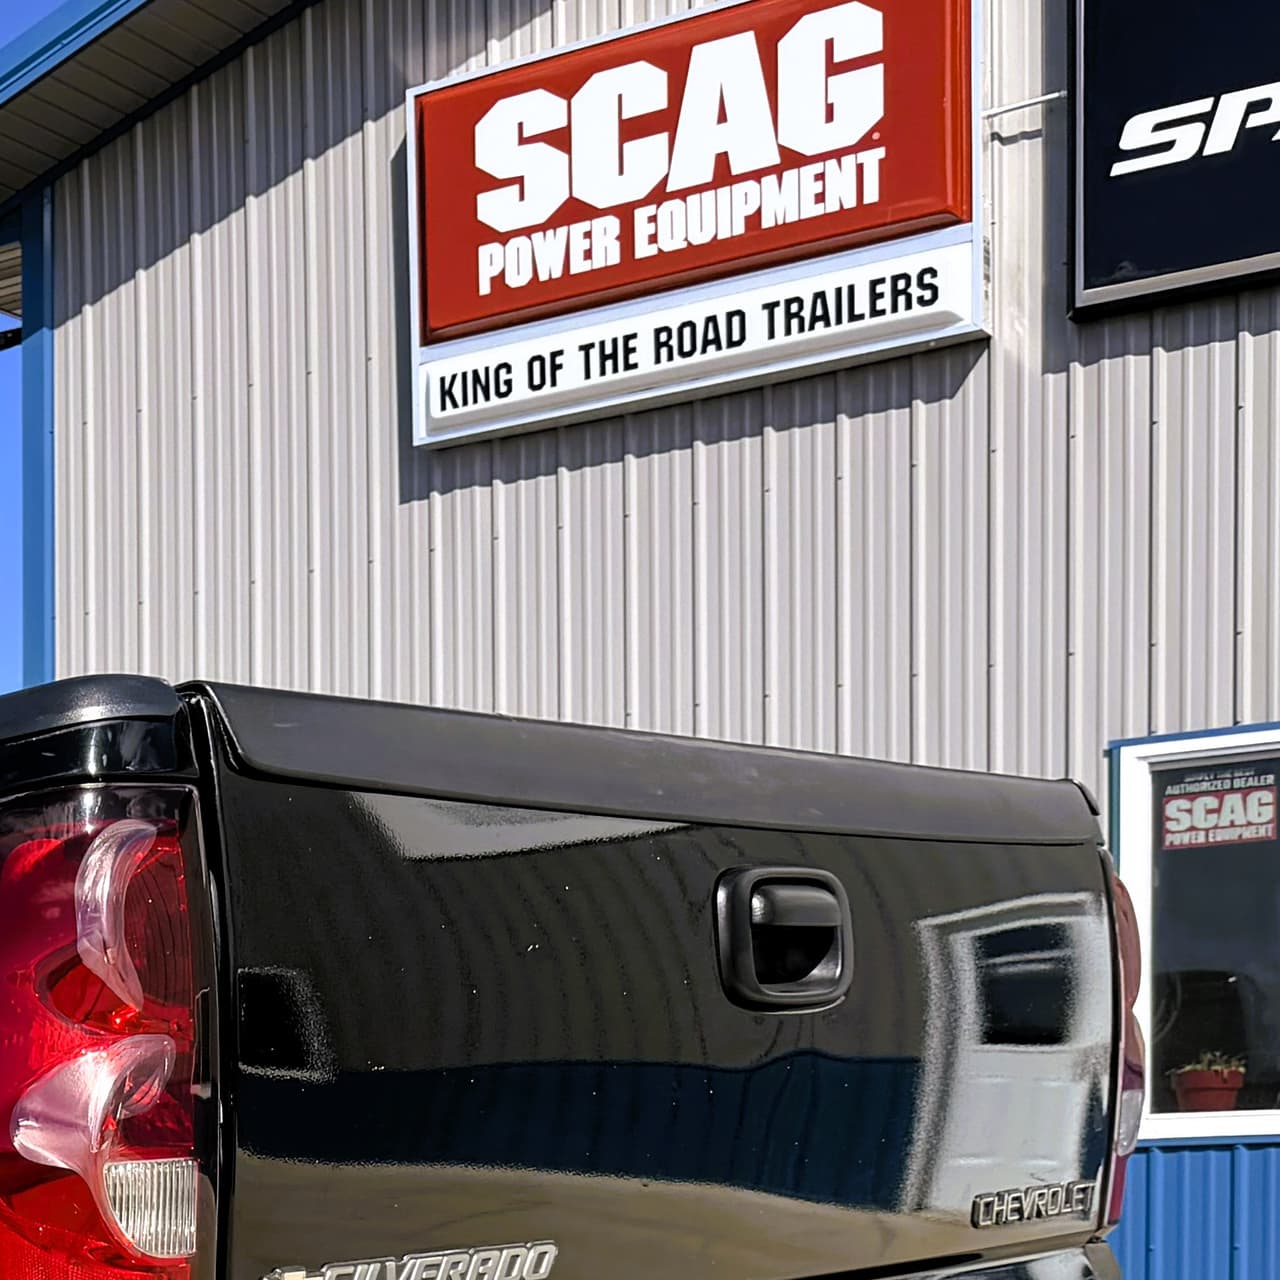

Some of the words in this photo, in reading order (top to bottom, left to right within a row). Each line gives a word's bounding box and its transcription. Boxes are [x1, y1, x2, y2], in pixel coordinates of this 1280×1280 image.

[475, 1, 885, 234] SCAG
[1109, 81, 1280, 178] SP
[477, 214, 621, 297] POWER
[633, 145, 887, 260] EQUIPMENT
[439, 361, 513, 413] KING
[526, 349, 565, 392] OF
[577, 332, 639, 381] THE
[653, 308, 747, 366] ROAD
[762, 266, 940, 341] TRAILERS
[1165, 780, 1231, 796] AUTHORIZED
[1233, 774, 1275, 789] DEALER
[1165, 790, 1274, 832] SCAG
[975, 1183, 1096, 1227] CHEVROLET
